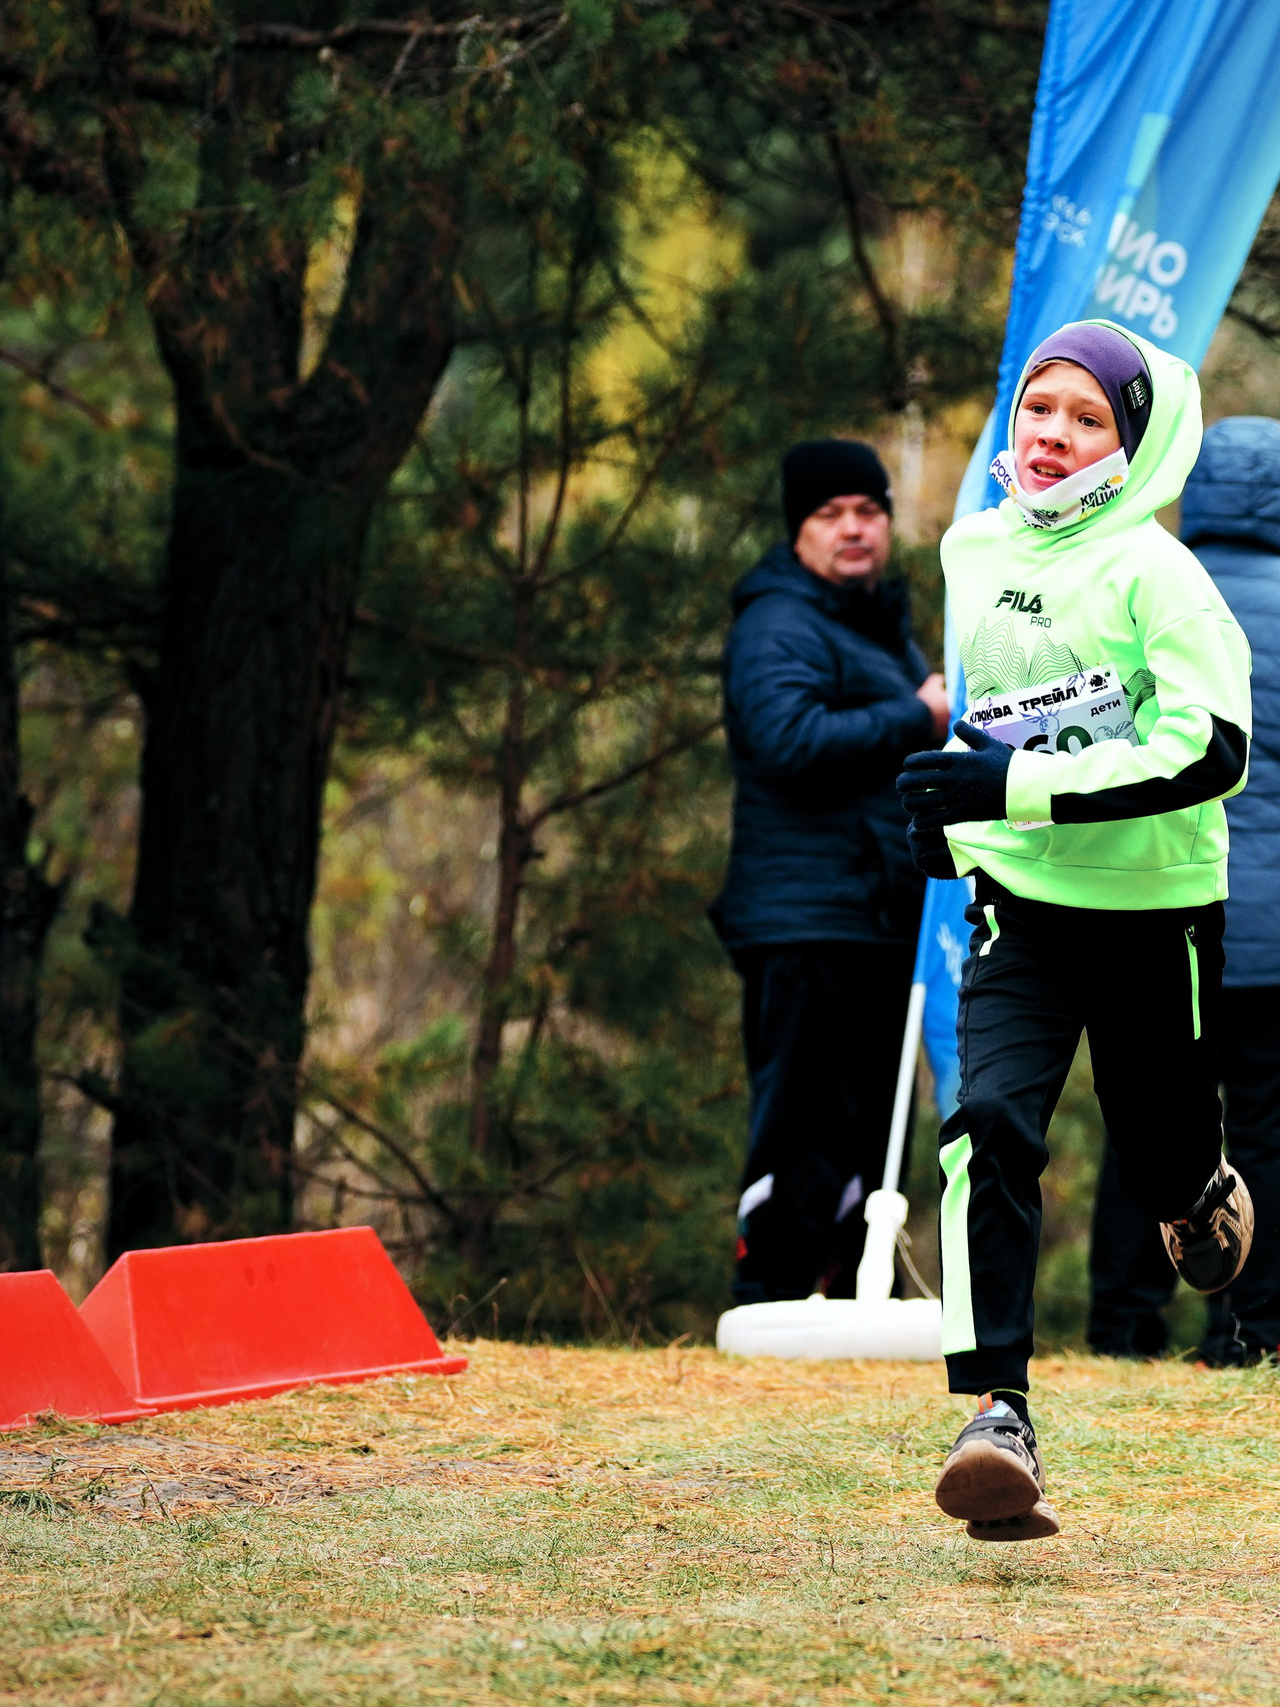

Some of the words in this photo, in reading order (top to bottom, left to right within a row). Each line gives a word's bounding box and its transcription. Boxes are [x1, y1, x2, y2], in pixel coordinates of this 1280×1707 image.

[1106, 212, 1188, 287] ИО
[1095, 264, 1179, 339] ИРЬ
[1132, 380, 1145, 407] GOALS
[994, 589, 1044, 614] FILA
[1030, 616, 1052, 628] PRO
[969, 704, 1014, 725] КЛЮКВА
[1018, 687, 1078, 712] ТРЕЙЛ
[1090, 699, 1121, 717] дети
